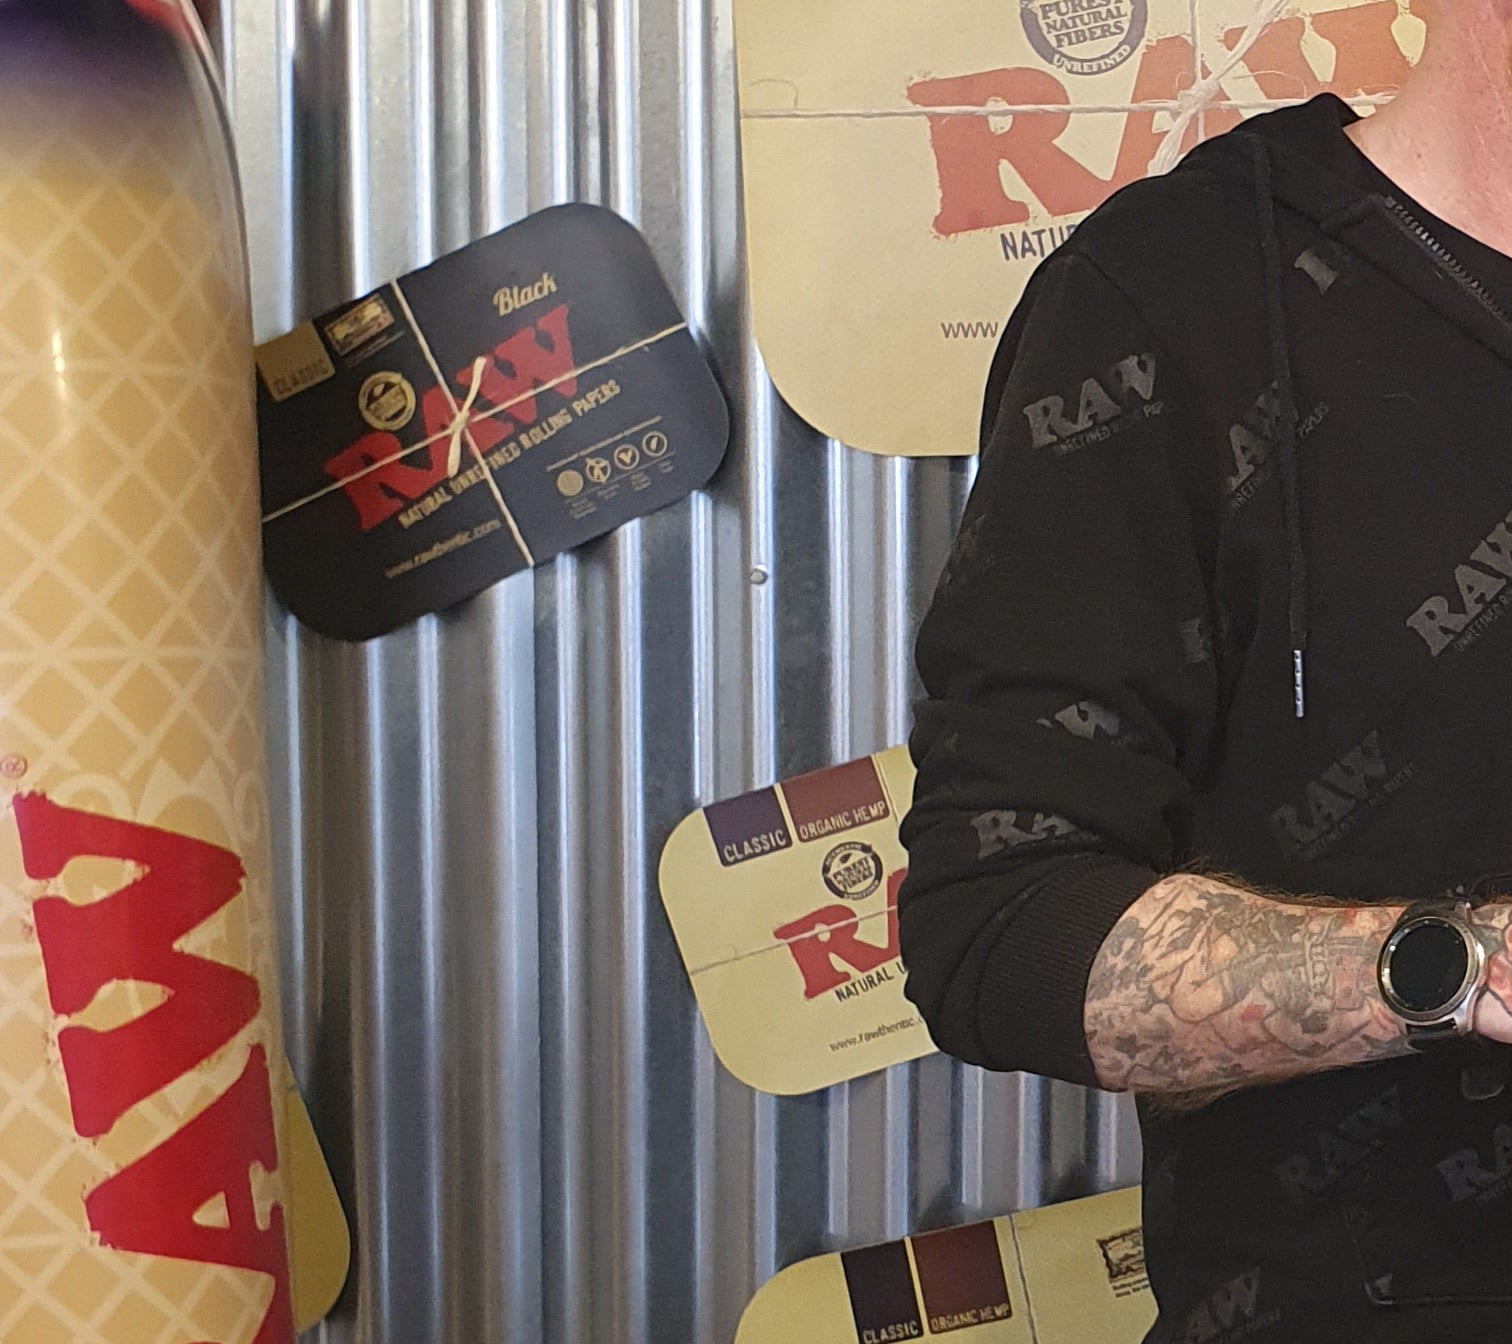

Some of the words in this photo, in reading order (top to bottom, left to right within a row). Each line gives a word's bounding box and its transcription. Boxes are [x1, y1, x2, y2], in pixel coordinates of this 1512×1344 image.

[1044, 5, 1128, 35] NATURAL
[1054, 20, 1126, 49] FIBERS
[1052, 44, 1132, 74] UNREFINED
[492, 271, 558, 318] Black
[323, 303, 578, 532] RAW
[398, 484, 453, 530] NATURAL
[519, 407, 573, 450] ROLLING
[572, 379, 621, 417] PAPERS
[1271, 729, 1388, 844] RAW
[800, 812, 852, 841] ORGANIC
[854, 801, 887, 825] HEMP
[722, 829, 788, 863] CLASSIC
[834, 965, 895, 1003] NATURAL
[931, 1309, 979, 1333] ORGANIC
[981, 1303, 1010, 1327] HEMP
